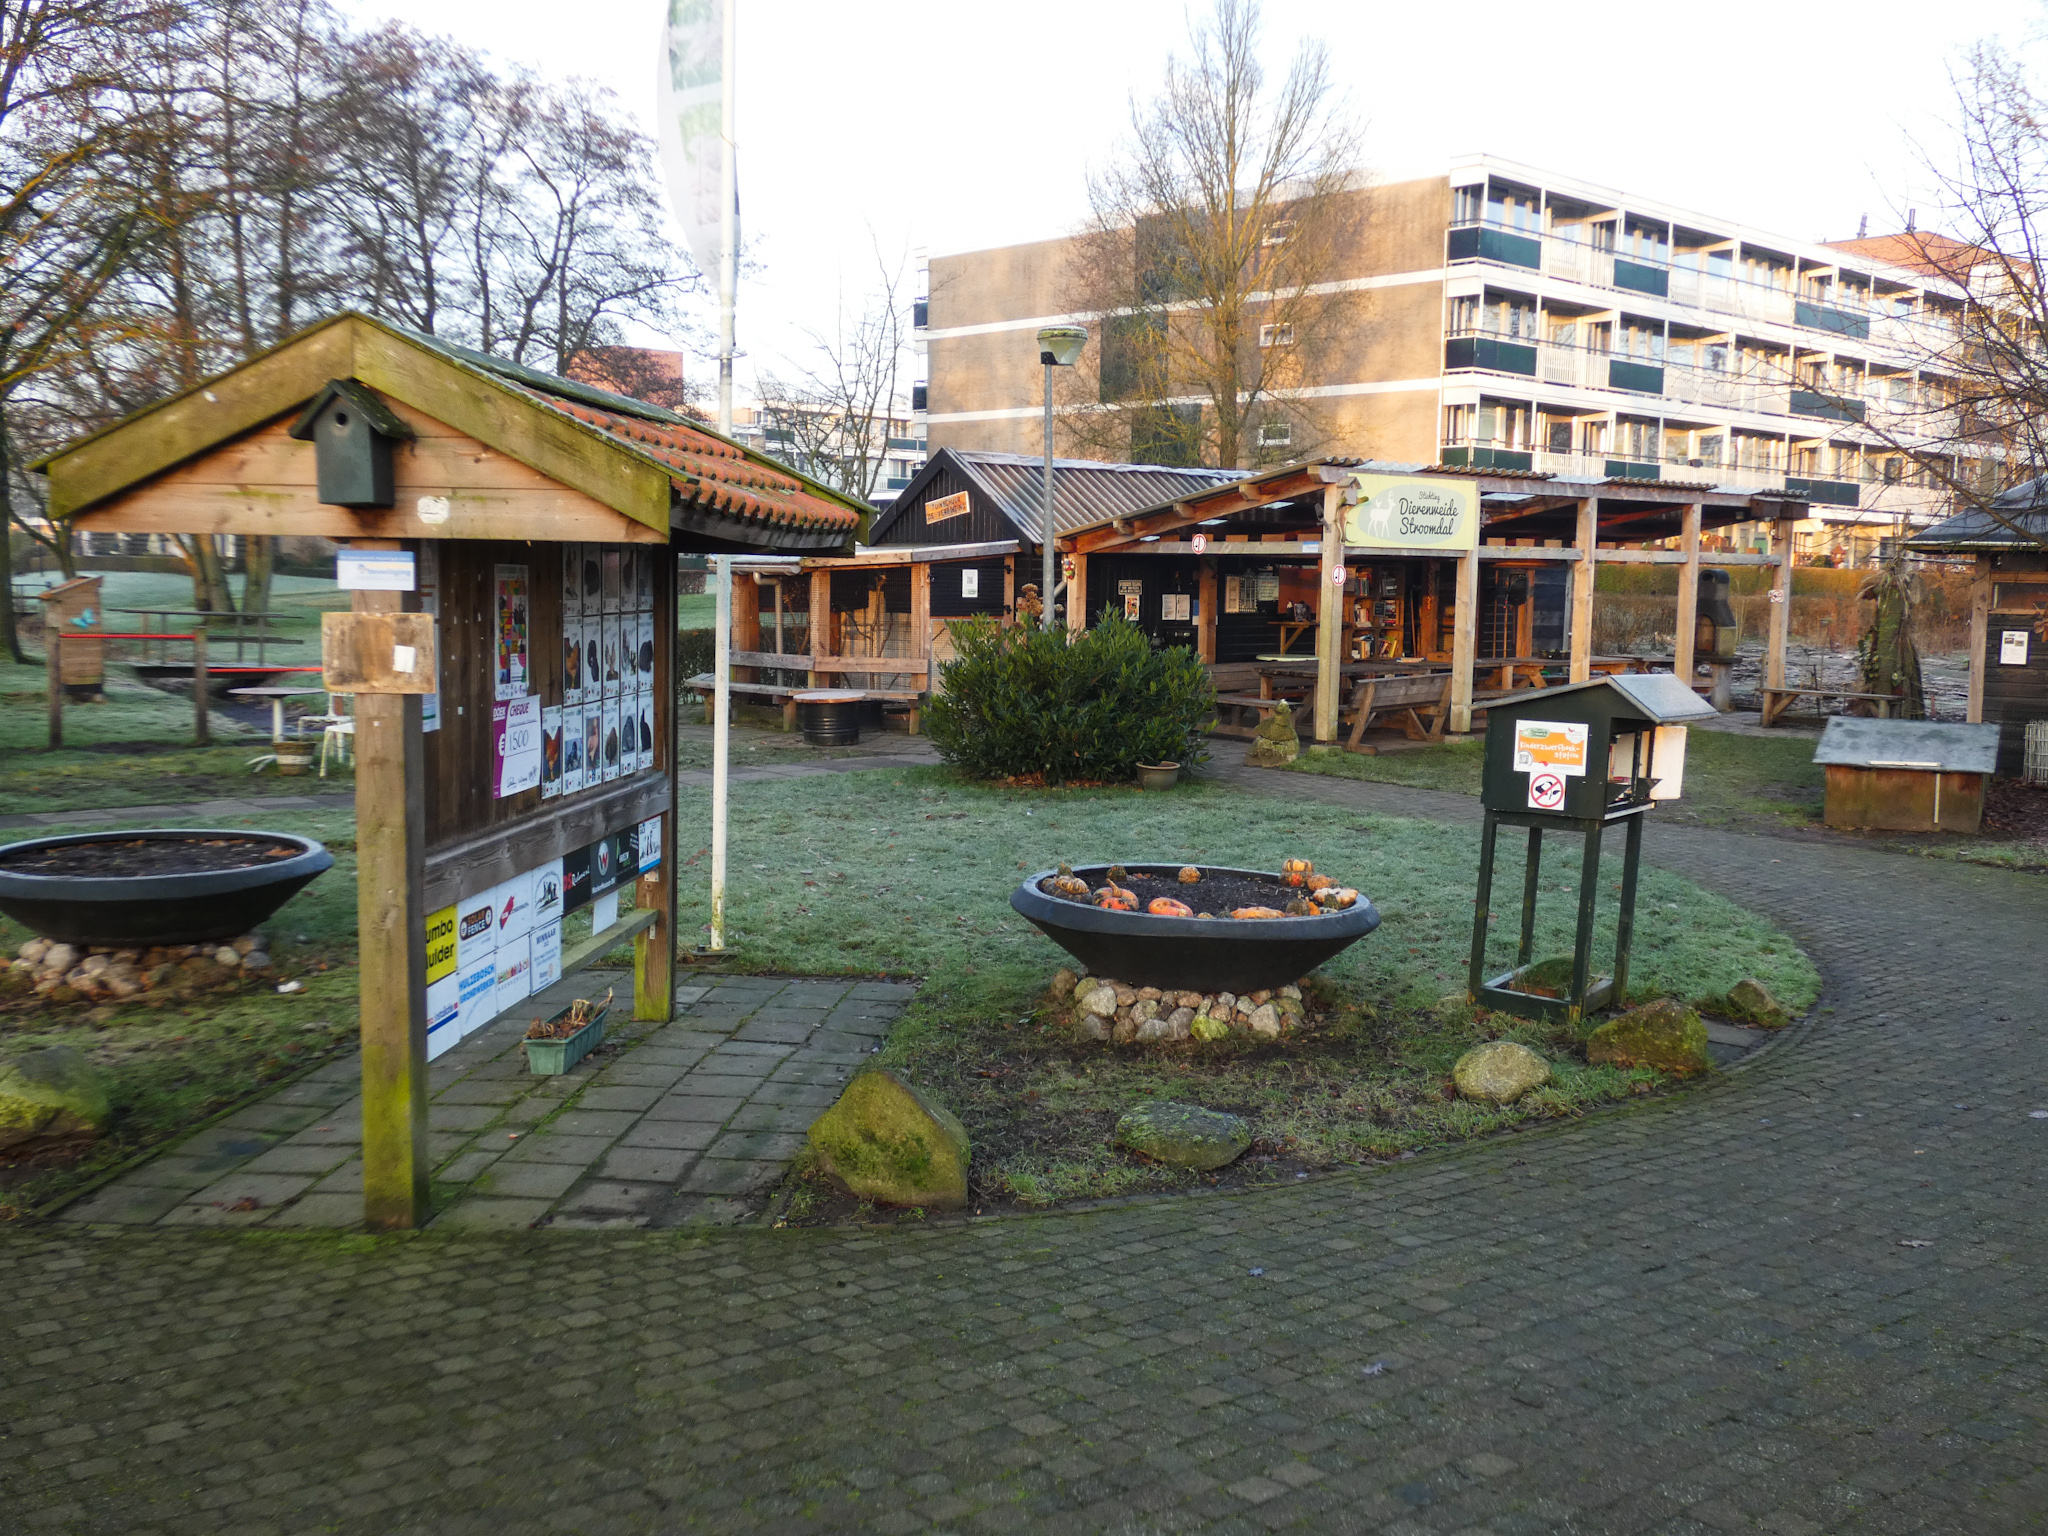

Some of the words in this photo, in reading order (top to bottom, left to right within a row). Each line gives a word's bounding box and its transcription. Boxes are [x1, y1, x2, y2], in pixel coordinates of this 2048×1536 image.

[1398, 497, 1459, 517] Dierenweide
[1399, 516, 1454, 535] Stroomdal
[509, 702, 530, 717] CHEQUE
[508, 729, 529, 752] 1500
[1554, 751, 1580, 760] station
[467, 910, 486, 925] SOLAR
[425, 918, 454, 943] umbo
[467, 919, 486, 936] FENCE
[459, 978, 496, 1005] GRONDWERKEN
